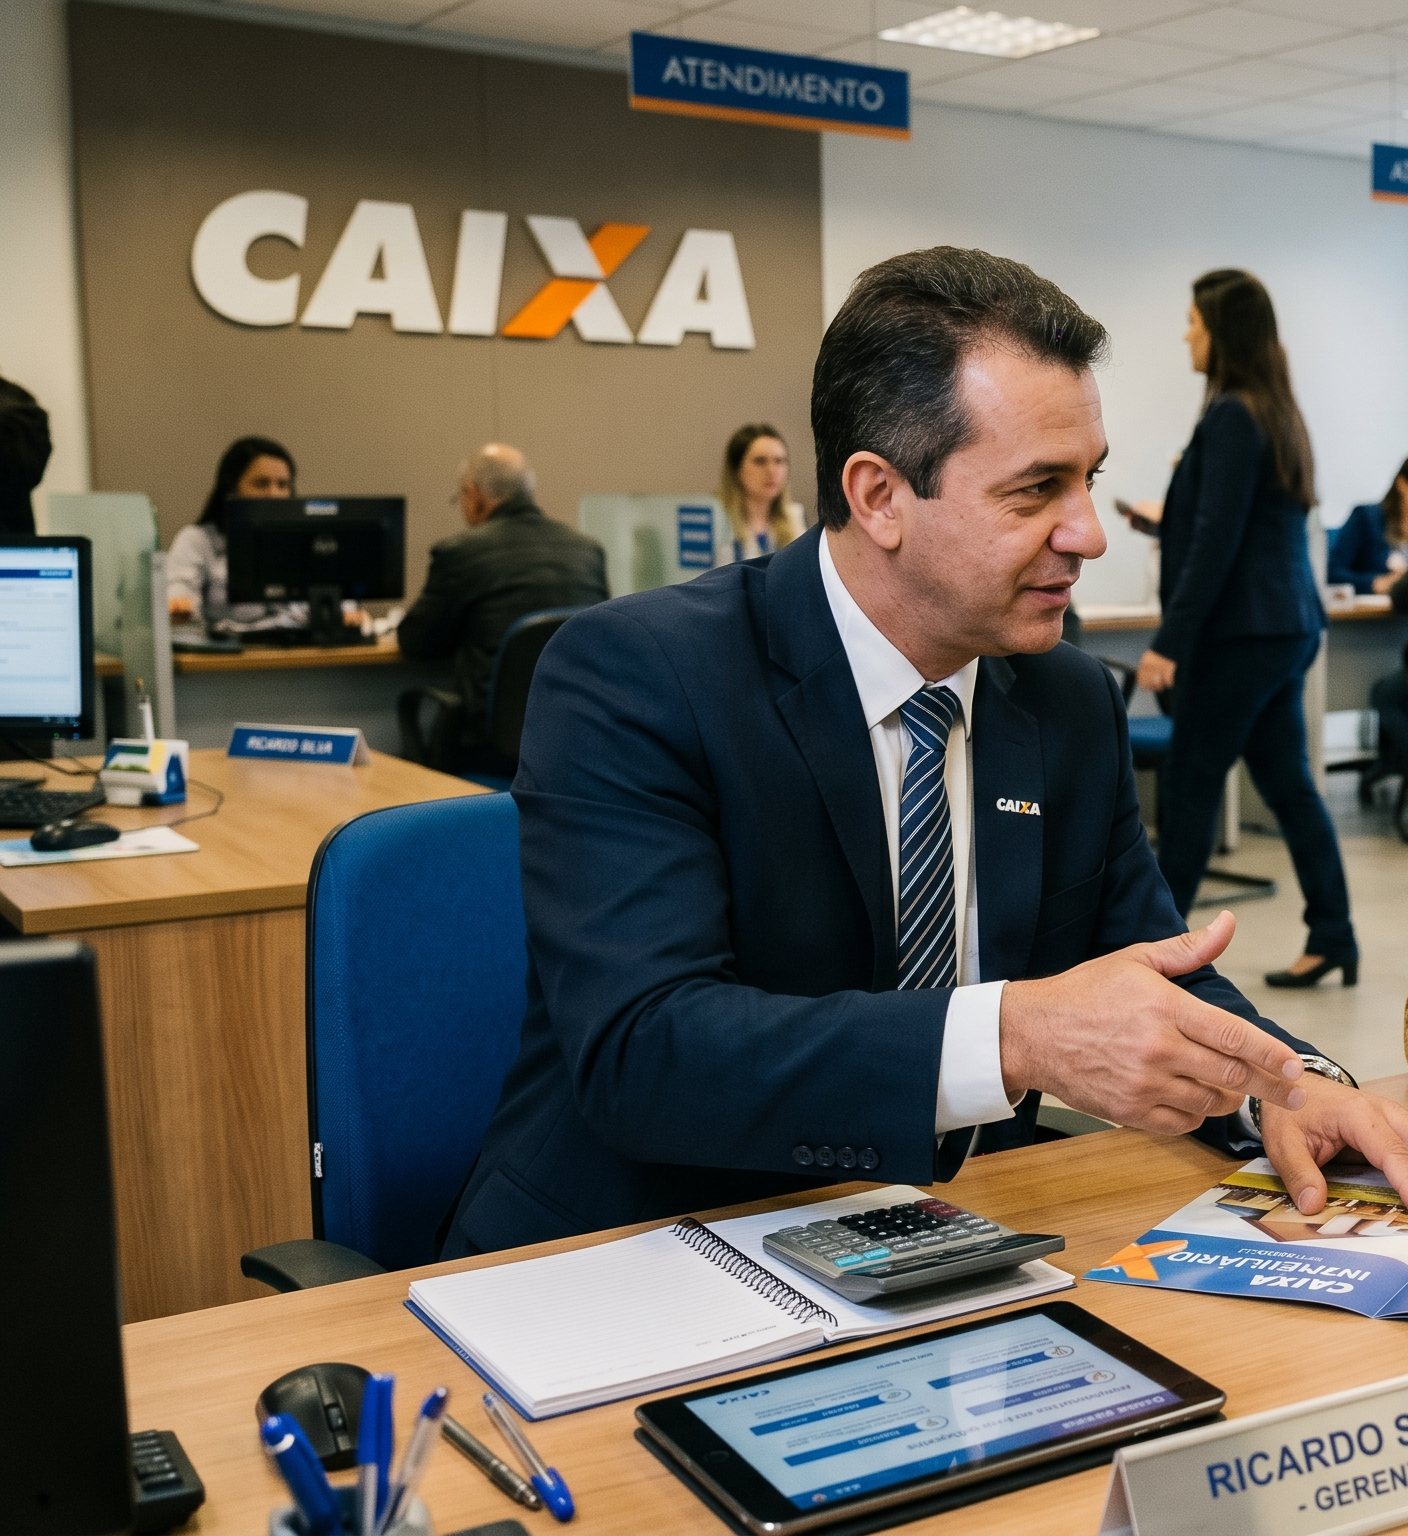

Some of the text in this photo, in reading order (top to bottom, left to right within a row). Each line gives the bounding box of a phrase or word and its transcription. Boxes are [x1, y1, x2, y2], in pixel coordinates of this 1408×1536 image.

[661, 55, 886, 112] ATENDIMENTO
[191, 190, 755, 349] CAIXA
[996, 797, 1041, 816] CAIXA
[1250, 1274, 1354, 1294] CAIXA
[1206, 1422, 1384, 1499] RICARDO
